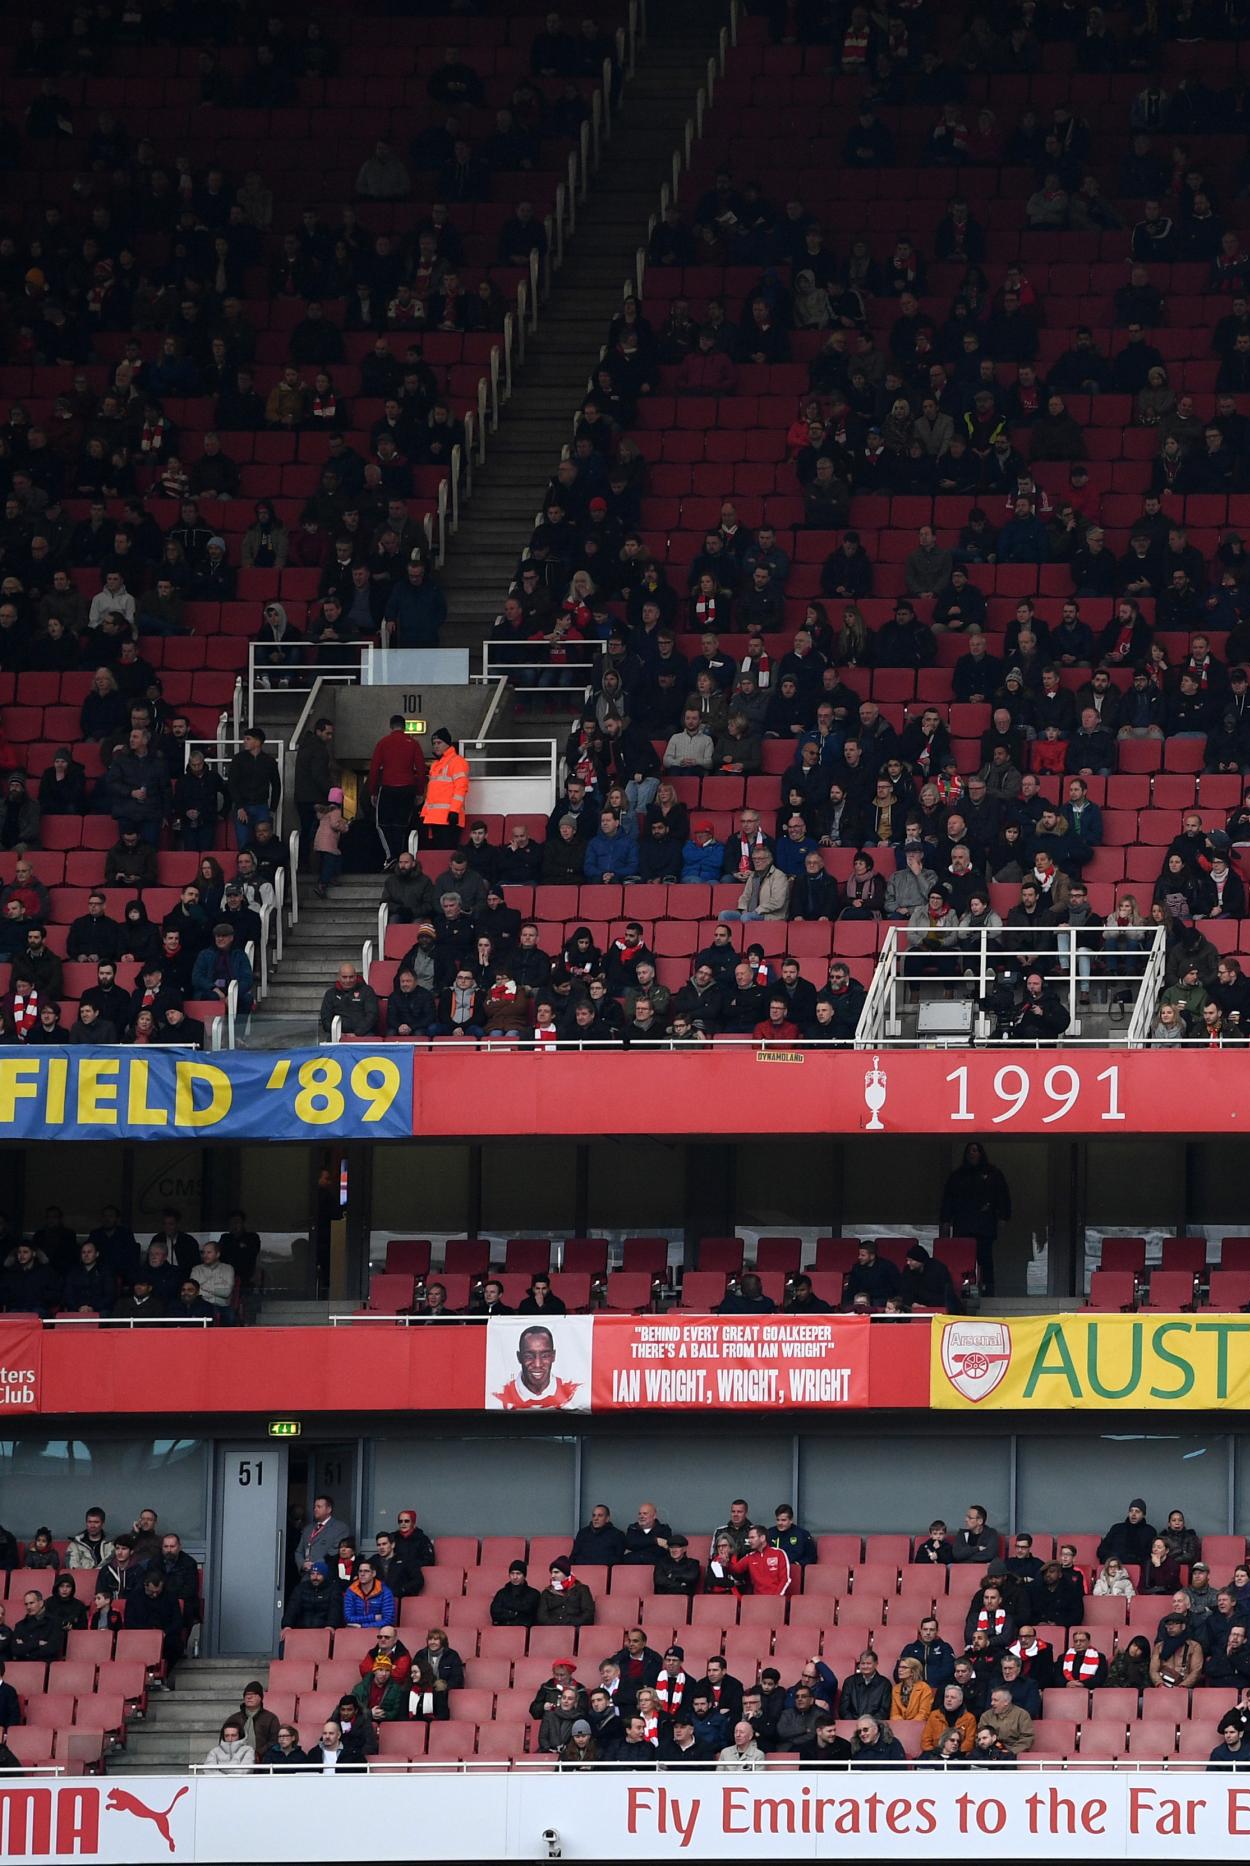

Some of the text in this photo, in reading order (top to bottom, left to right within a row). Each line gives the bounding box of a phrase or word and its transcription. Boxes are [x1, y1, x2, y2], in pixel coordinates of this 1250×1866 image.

[403, 695, 422, 713] 101
[266, 1057, 401, 1125] '89
[946, 1064, 1125, 1123] 1991
[635, 1327, 831, 1341] "BEHIND EVERY GREAT GOALKEEPER
[950, 1333, 1001, 1346] Arsenal
[631, 1343, 834, 1358] THERE'S A BALL FROM IAN WRIGHT"
[613, 1369, 851, 1403] IAN WRIGHT, WRIGHT, WRIGHT
[239, 1461, 263, 1485] 51
[627, 1787, 700, 1847] Fly
[722, 1787, 937, 1834] Emirates
[955, 1792, 1007, 1834] to
[1025, 1787, 1107, 1834] the
[1129, 1787, 1207, 1835] Far
